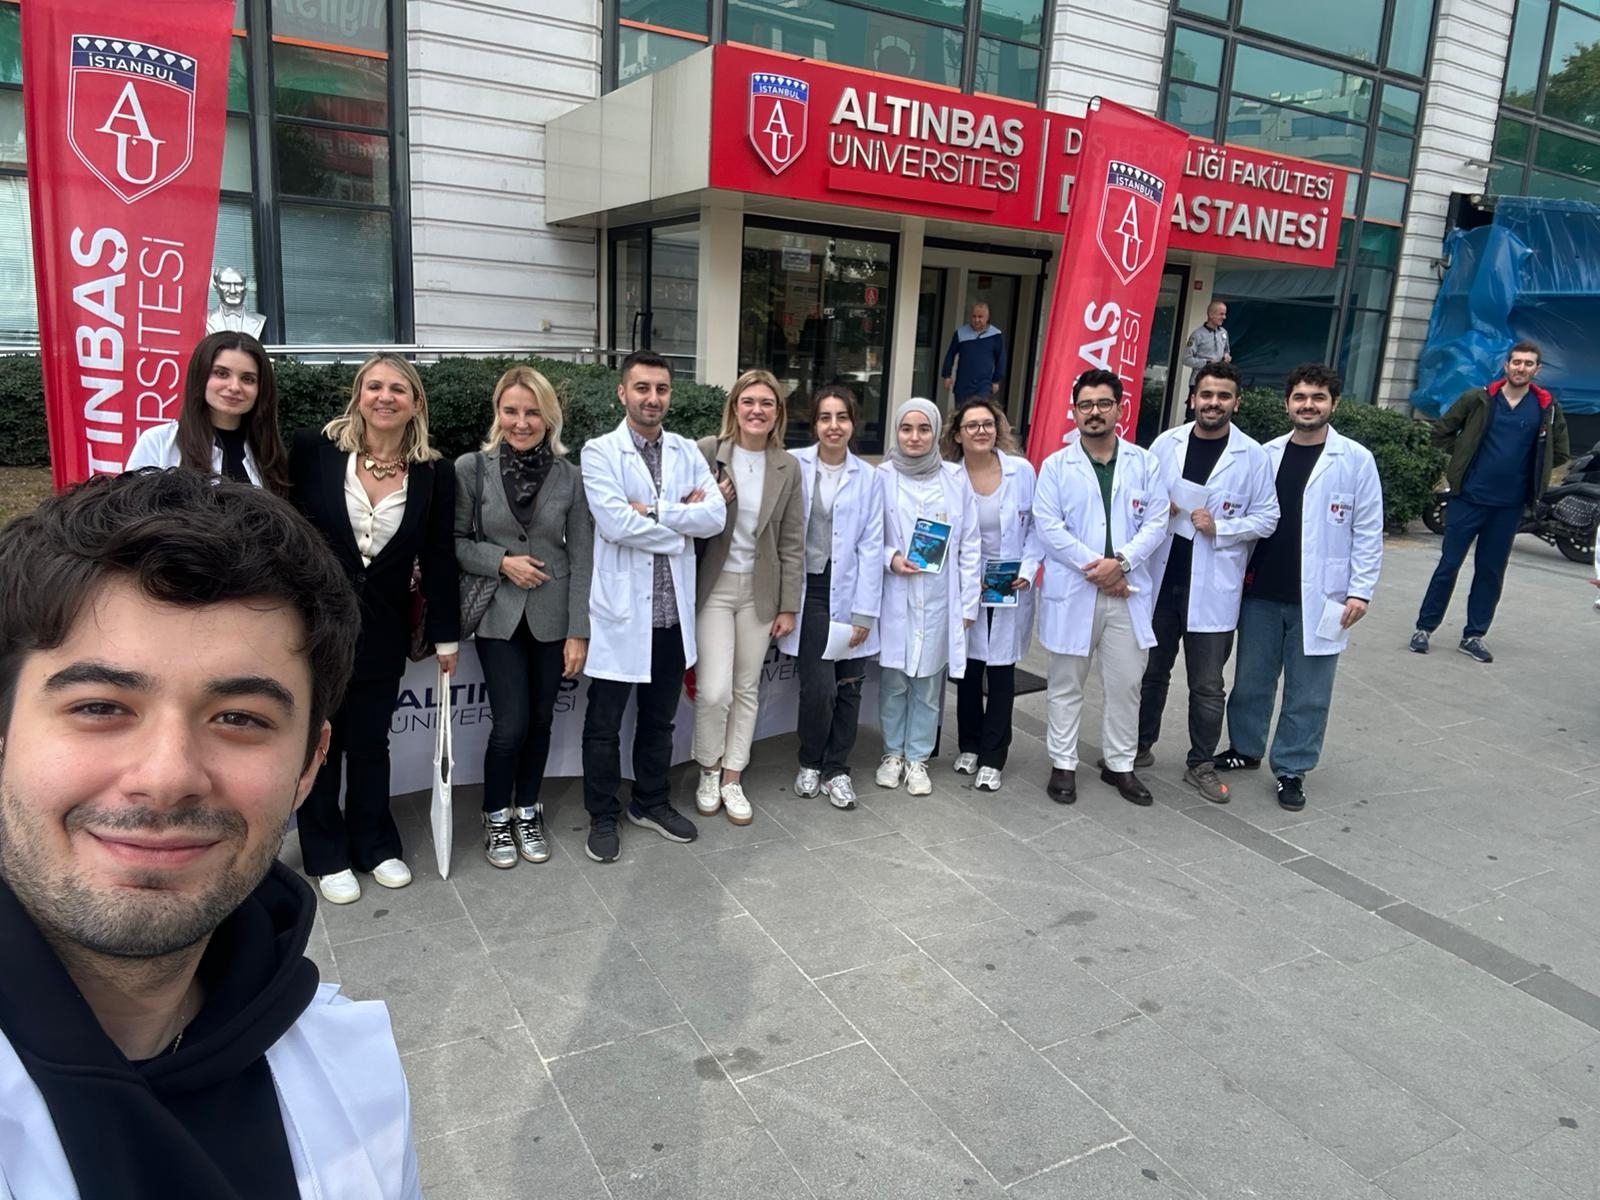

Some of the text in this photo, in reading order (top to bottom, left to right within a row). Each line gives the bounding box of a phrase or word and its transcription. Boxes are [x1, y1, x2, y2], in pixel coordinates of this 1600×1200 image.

[88, 52, 178, 84] İSTANBUL
[759, 86, 800, 100] İSTANBUL
[829, 87, 1024, 157] ALTINBAŞ
[829, 131, 1020, 192] ÜNİVERSİTESİ
[1115, 174, 1155, 200] İSTANBUL
[1231, 159, 1334, 200] FAKÜLTESİ
[1171, 192, 1329, 250] ASTANESİ
[70, 226, 129, 475] TINBAŞ
[136, 236, 185, 438] RSİTESİ
